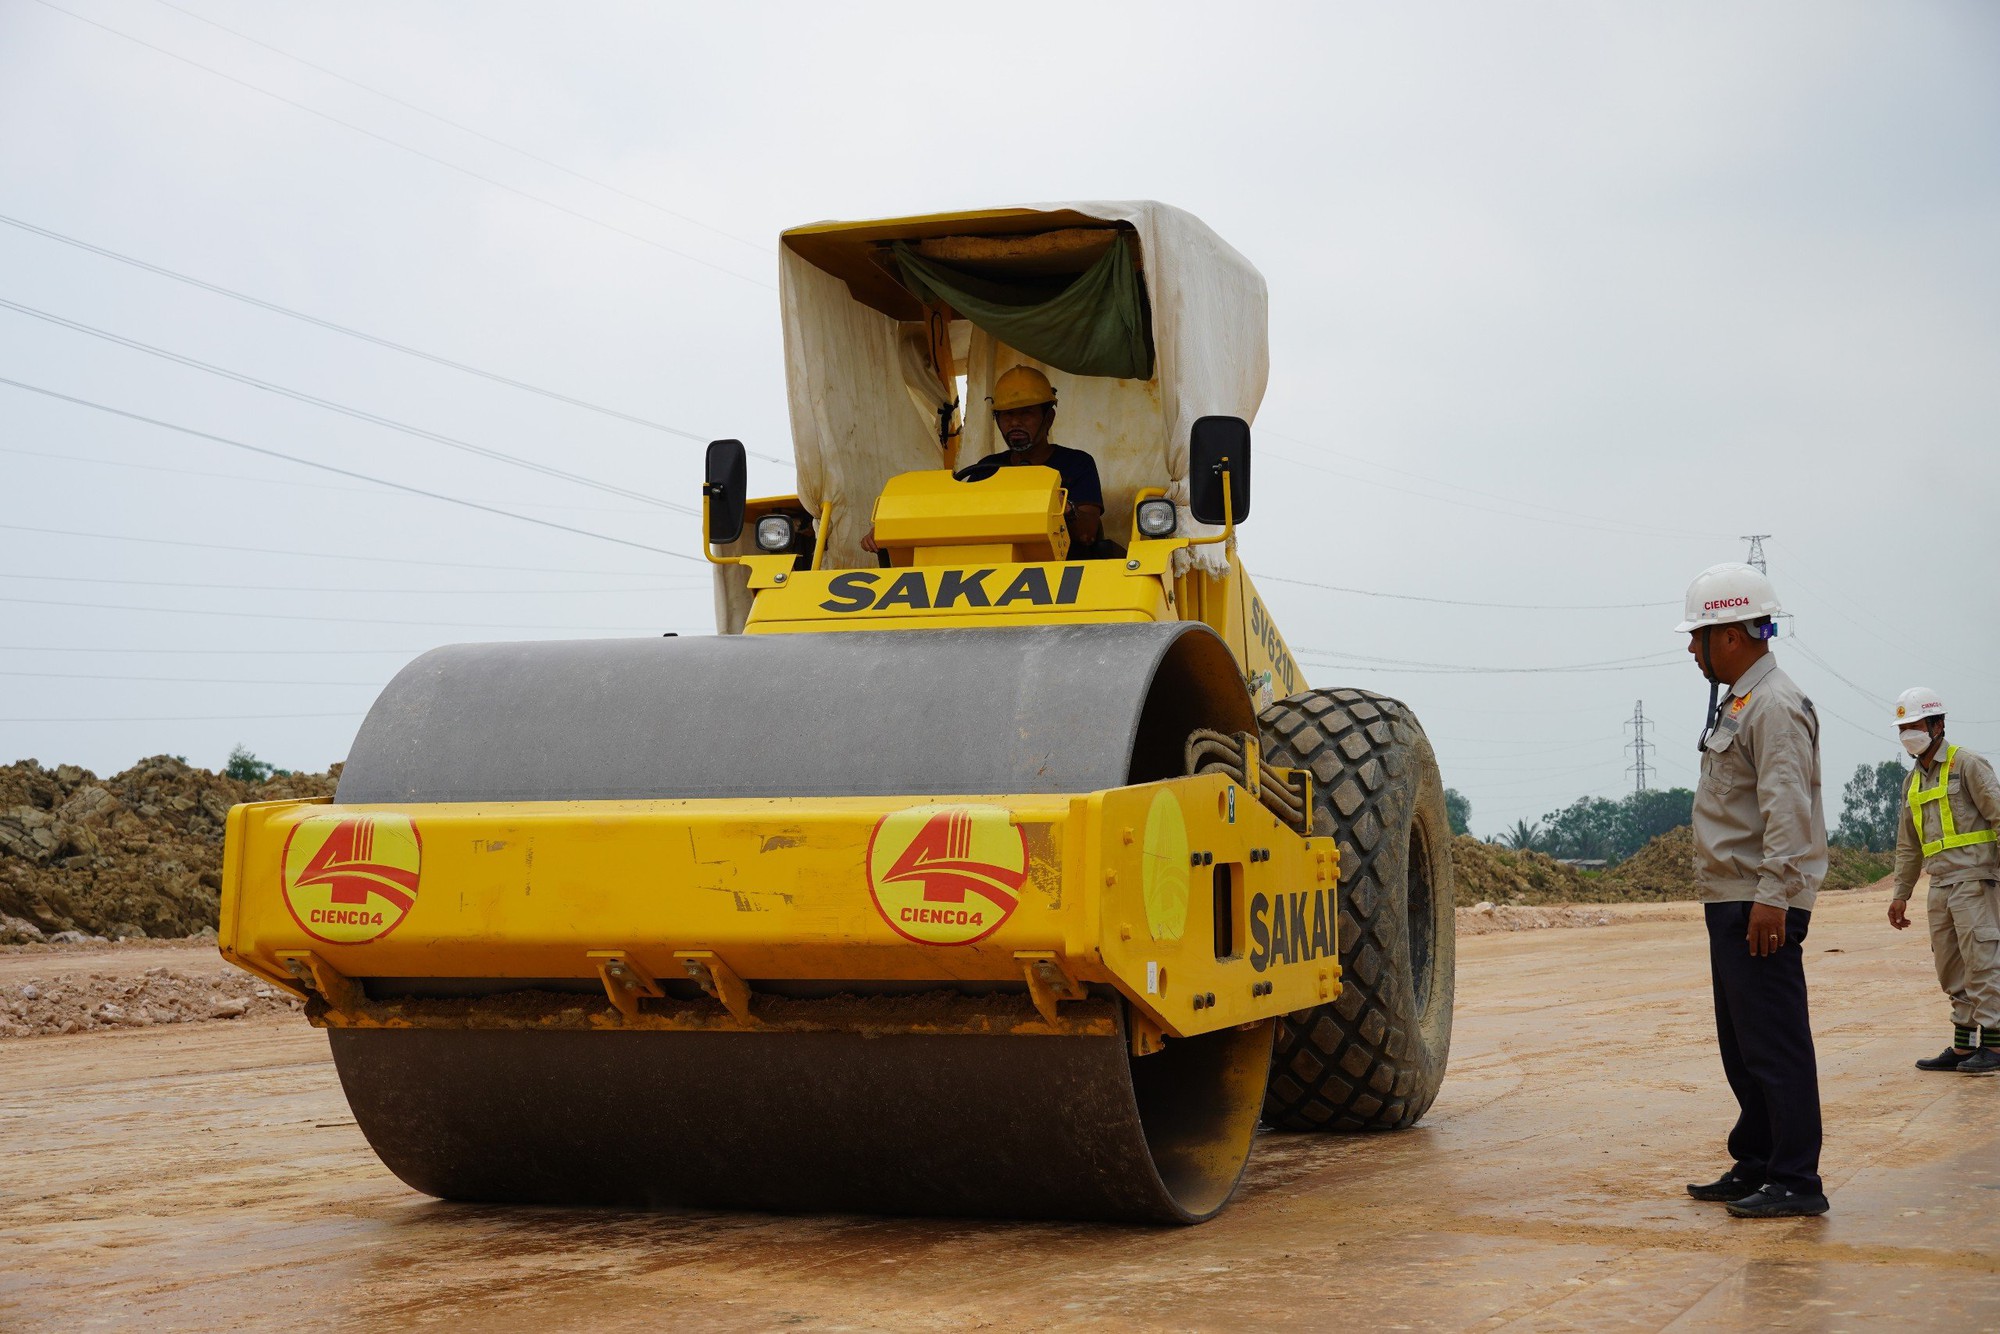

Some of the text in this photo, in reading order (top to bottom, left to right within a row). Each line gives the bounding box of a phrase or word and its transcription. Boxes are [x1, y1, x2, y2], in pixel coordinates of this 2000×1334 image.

[818, 565, 1085, 613] SAKAI
[1704, 597, 1749, 610] CIENCO4
[1251, 596, 1294, 695] SV621D
[310, 909, 384, 926] CIENCO4
[900, 907, 984, 926] CIENCO4
[1250, 888, 1336, 972] SAKAI
